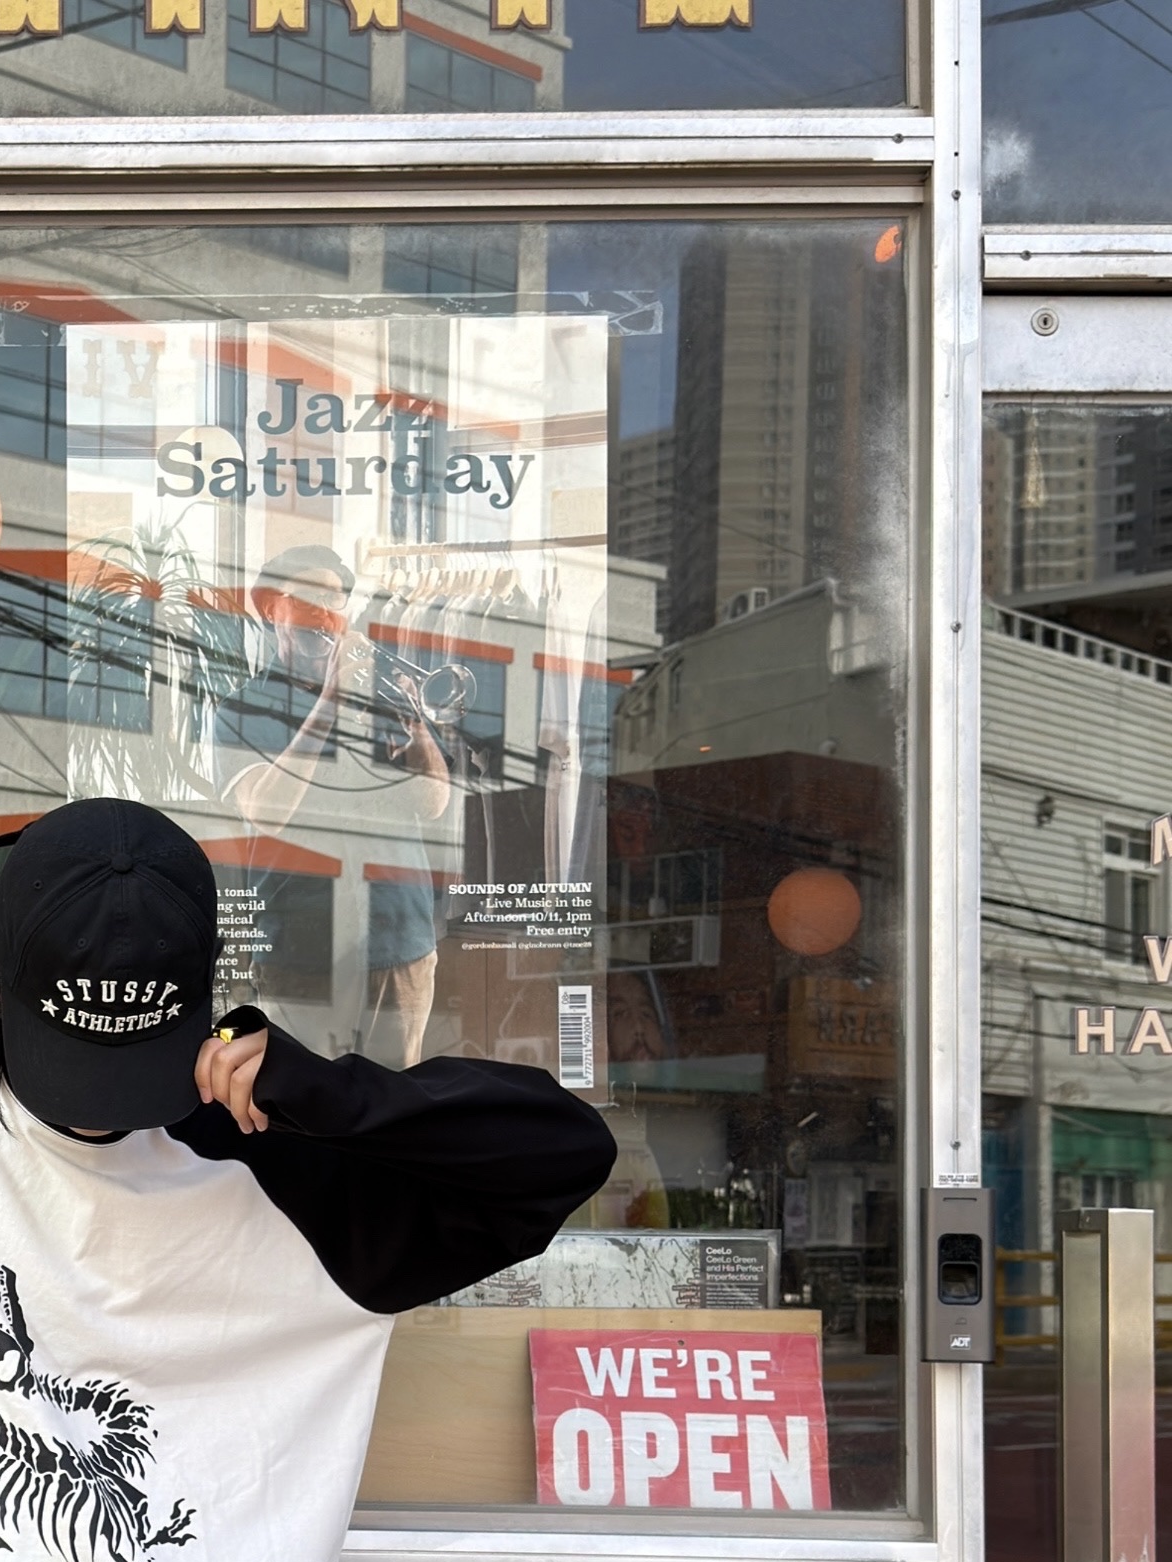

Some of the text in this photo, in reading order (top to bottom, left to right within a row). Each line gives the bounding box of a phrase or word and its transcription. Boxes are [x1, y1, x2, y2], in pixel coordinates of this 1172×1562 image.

[257, 378, 435, 435] Jazz
[156, 437, 535, 510] Saturday
[224, 886, 258, 897] tonal
[448, 882, 592, 895] SOUNDS OF AUTUMN
[236, 900, 266, 911] wild
[485, 897, 592, 908] Live Music in the
[217, 914, 253, 925] usical
[464, 912, 527, 923] Afternoon
[566, 912, 592, 925] 1pm
[217, 928, 267, 938] friends.
[526, 926, 592, 937] Free entry
[239, 944, 273, 952] more
[216, 957, 238, 965] nce
[232, 969, 254, 980] but
[56, 978, 179, 1006] STUSSY
[63, 1007, 164, 1033] ATHLETICS
[705, 1246, 732, 1255] CeeLo
[705, 1255, 757, 1264] CeeLo Green
[706, 1264, 764, 1273] and His Perfect
[706, 1273, 759, 1282] Imperfections
[950, 1337, 971, 1347] ADT
[575, 1347, 775, 1401] WE'RE
[552, 1408, 815, 1510] OPEN
